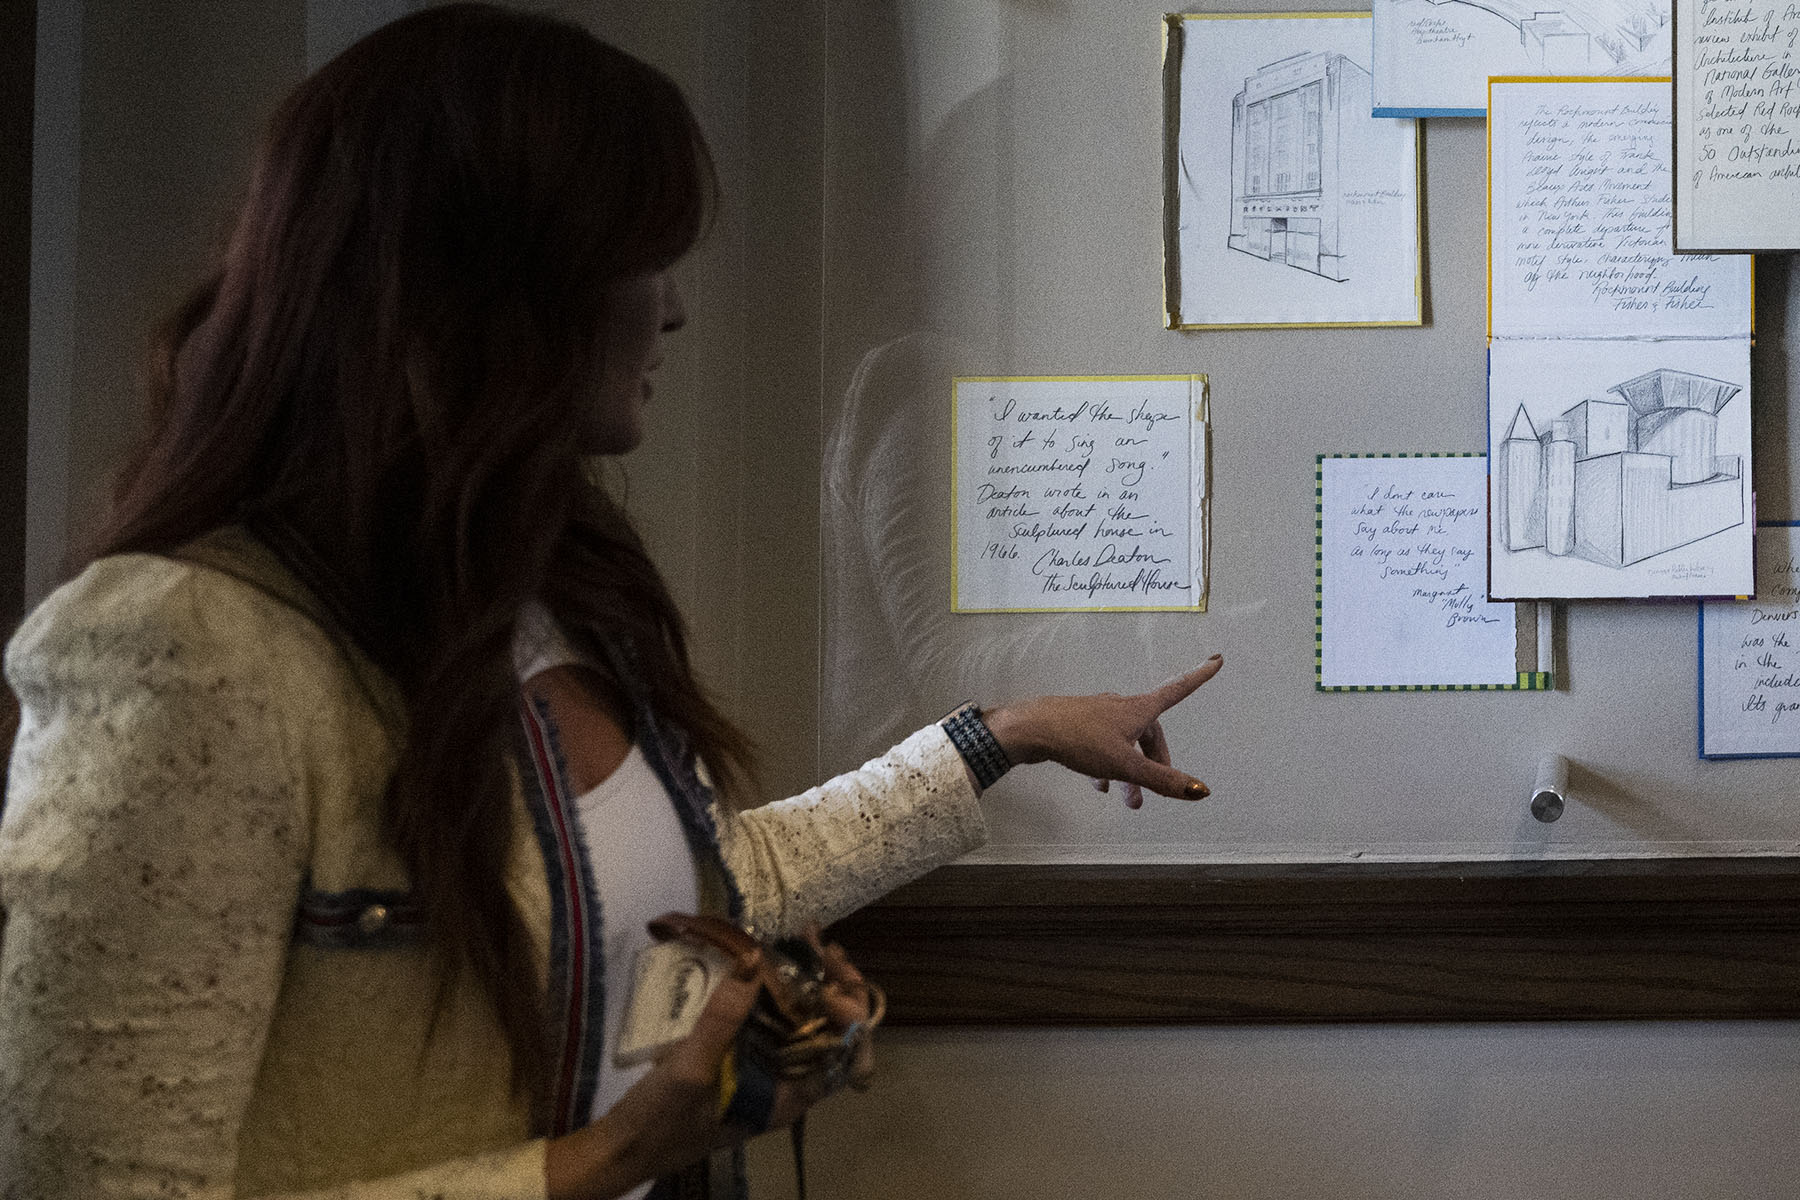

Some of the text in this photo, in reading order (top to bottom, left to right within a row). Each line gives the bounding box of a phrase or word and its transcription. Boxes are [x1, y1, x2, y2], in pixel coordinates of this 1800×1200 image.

[1721, 84, 1794, 101] Modern Art
[1699, 145, 1716, 163] 50
[1592, 276, 1711, 303] Rockmount Building
[1018, 400, 1181, 431] wanted the shape
[988, 429, 1148, 457] of it to sing an
[988, 458, 1091, 478] unencumbered
[977, 483, 1139, 504] Deaton wrote in an
[1421, 491, 1455, 499] care
[986, 502, 1149, 520] article about the
[1351, 505, 1414, 516] what the
[1094, 518, 1173, 538] house in
[1383, 521, 1419, 534] about
[980, 544, 1171, 575] 1966. Charles Deaton
[1370, 544, 1474, 564] long they say
[1042, 575, 1064, 593] The
[1141, 568, 1192, 595] House
[1447, 613, 1500, 627] Brown
[1773, 632, 1790, 648] the
[1735, 656, 1747, 670] in
[1757, 653, 1782, 669] the
